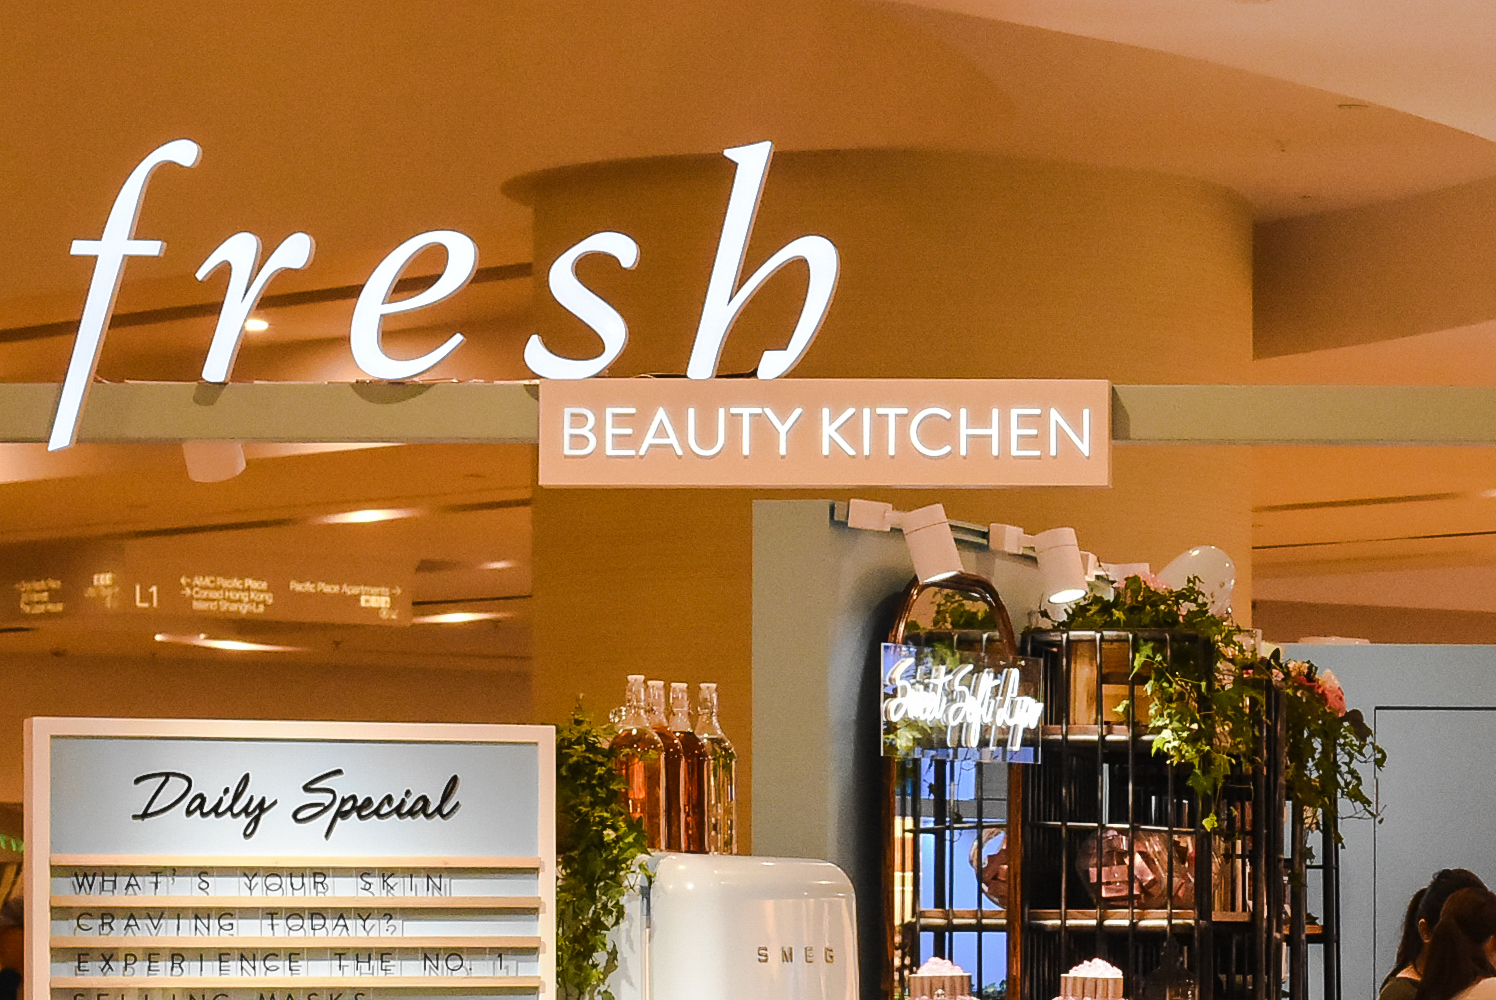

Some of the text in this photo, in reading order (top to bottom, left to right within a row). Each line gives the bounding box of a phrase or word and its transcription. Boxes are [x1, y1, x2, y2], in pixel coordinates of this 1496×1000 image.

[44, 137, 840, 452] fresh
[562, 406, 1092, 458] BEAUTY KITCHEN
[244, 577, 268, 591] Place
[317, 581, 340, 593] Place
[135, 584, 158, 608] L1
[225, 589, 249, 603] Hong
[250, 591, 274, 605] Kong
[131, 767, 462, 842] Daily Special
[243, 871, 327, 892] YOUR
[359, 871, 443, 892] SKIN
[76, 911, 394, 933] CRAVING TODAY?
[77, 952, 504, 972] EXPERIENCE THE NO. 1
[757, 946, 835, 964] SMEG
